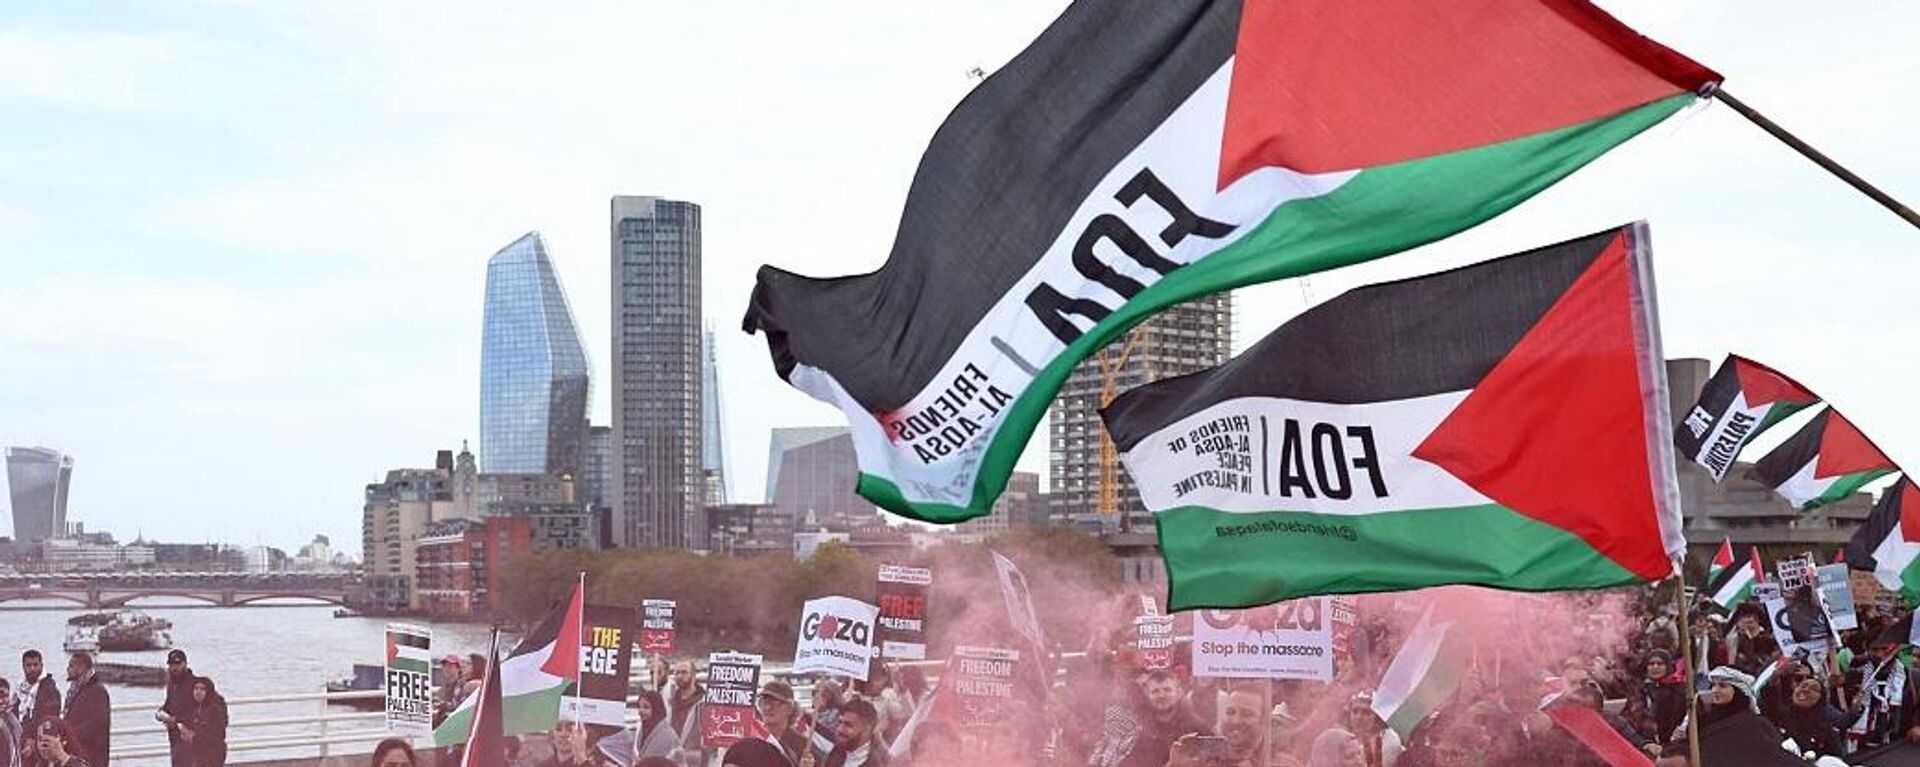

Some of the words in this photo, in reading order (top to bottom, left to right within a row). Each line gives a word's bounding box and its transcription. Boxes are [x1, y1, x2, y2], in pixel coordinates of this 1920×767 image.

[882, 595, 922, 617] FREE
[593, 627, 621, 648] THE
[803, 612, 869, 647] Gza
[1201, 641, 1235, 657] Stop
[1237, 641, 1260, 655] the
[1262, 641, 1324, 658] massacre
[581, 646, 619, 675] EGE
[961, 659, 1012, 677] FREEDOM
[711, 666, 754, 683] FREEDOM
[387, 670, 429, 701] FREE
[706, 687, 754, 705] PALESTINE
[387, 698, 430, 715] PALESTINE
